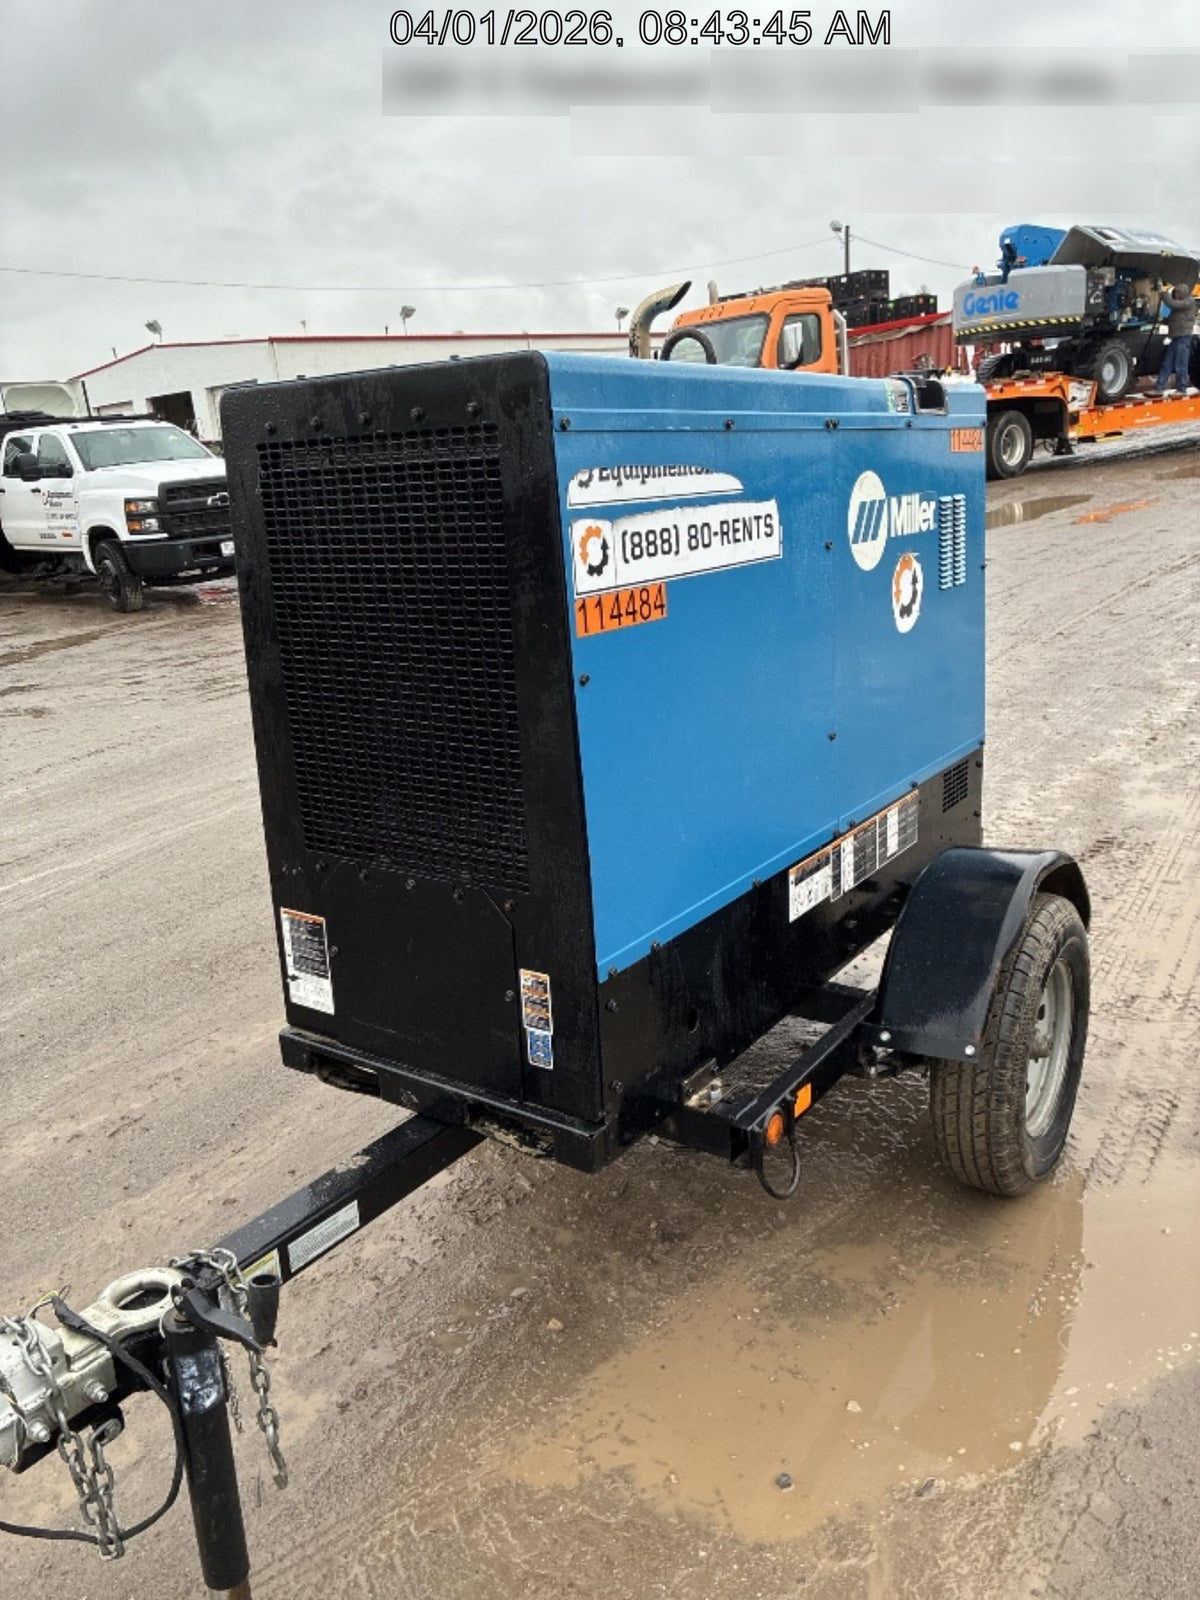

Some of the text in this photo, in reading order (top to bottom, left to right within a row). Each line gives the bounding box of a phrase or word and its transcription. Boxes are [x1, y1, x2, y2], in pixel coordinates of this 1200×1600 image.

[963, 288, 1020, 317] Genie
[621, 513, 775, 564] (888) 80-RENTS
[890, 492, 936, 538] Miller
[577, 584, 666, 634] 114484
